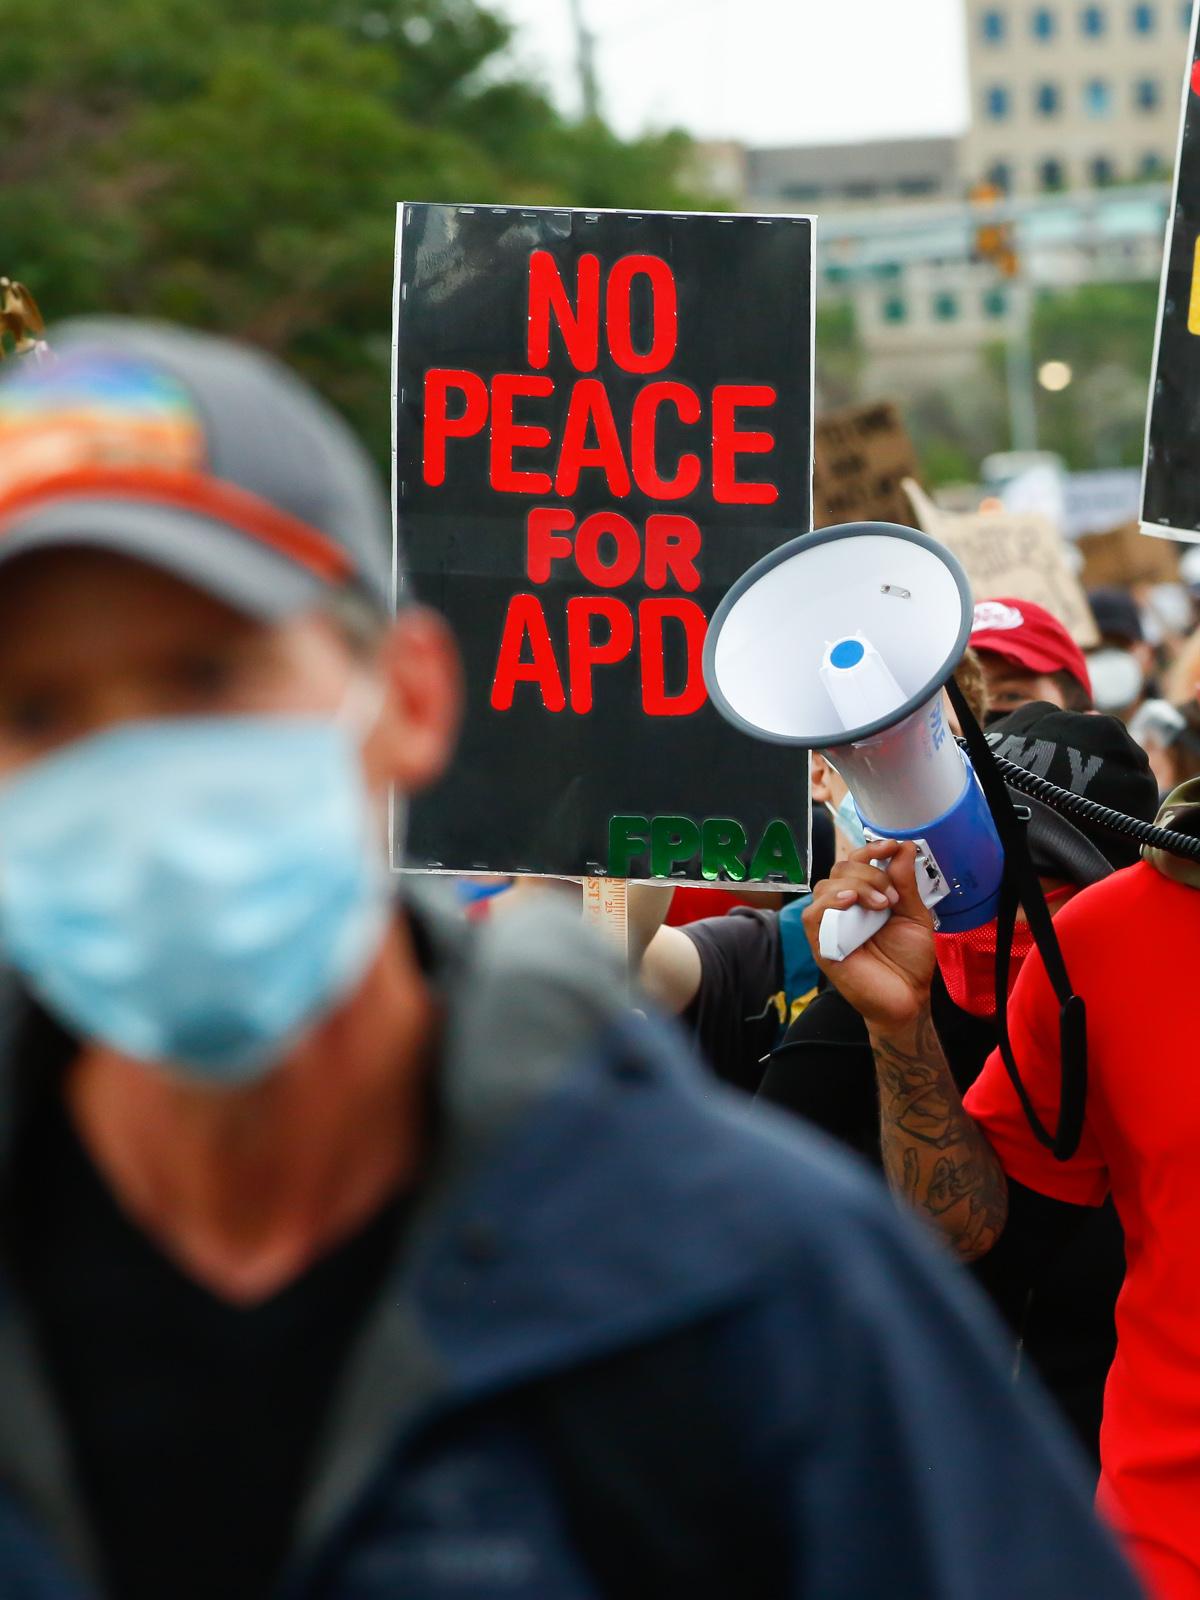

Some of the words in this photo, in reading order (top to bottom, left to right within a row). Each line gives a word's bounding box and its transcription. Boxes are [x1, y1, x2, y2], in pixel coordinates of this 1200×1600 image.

[526, 249, 678, 375] NO
[422, 367, 779, 505] PEACE
[526, 507, 701, 593] FOR
[490, 593, 709, 717] APD
[608, 814, 803, 884] FPRA
